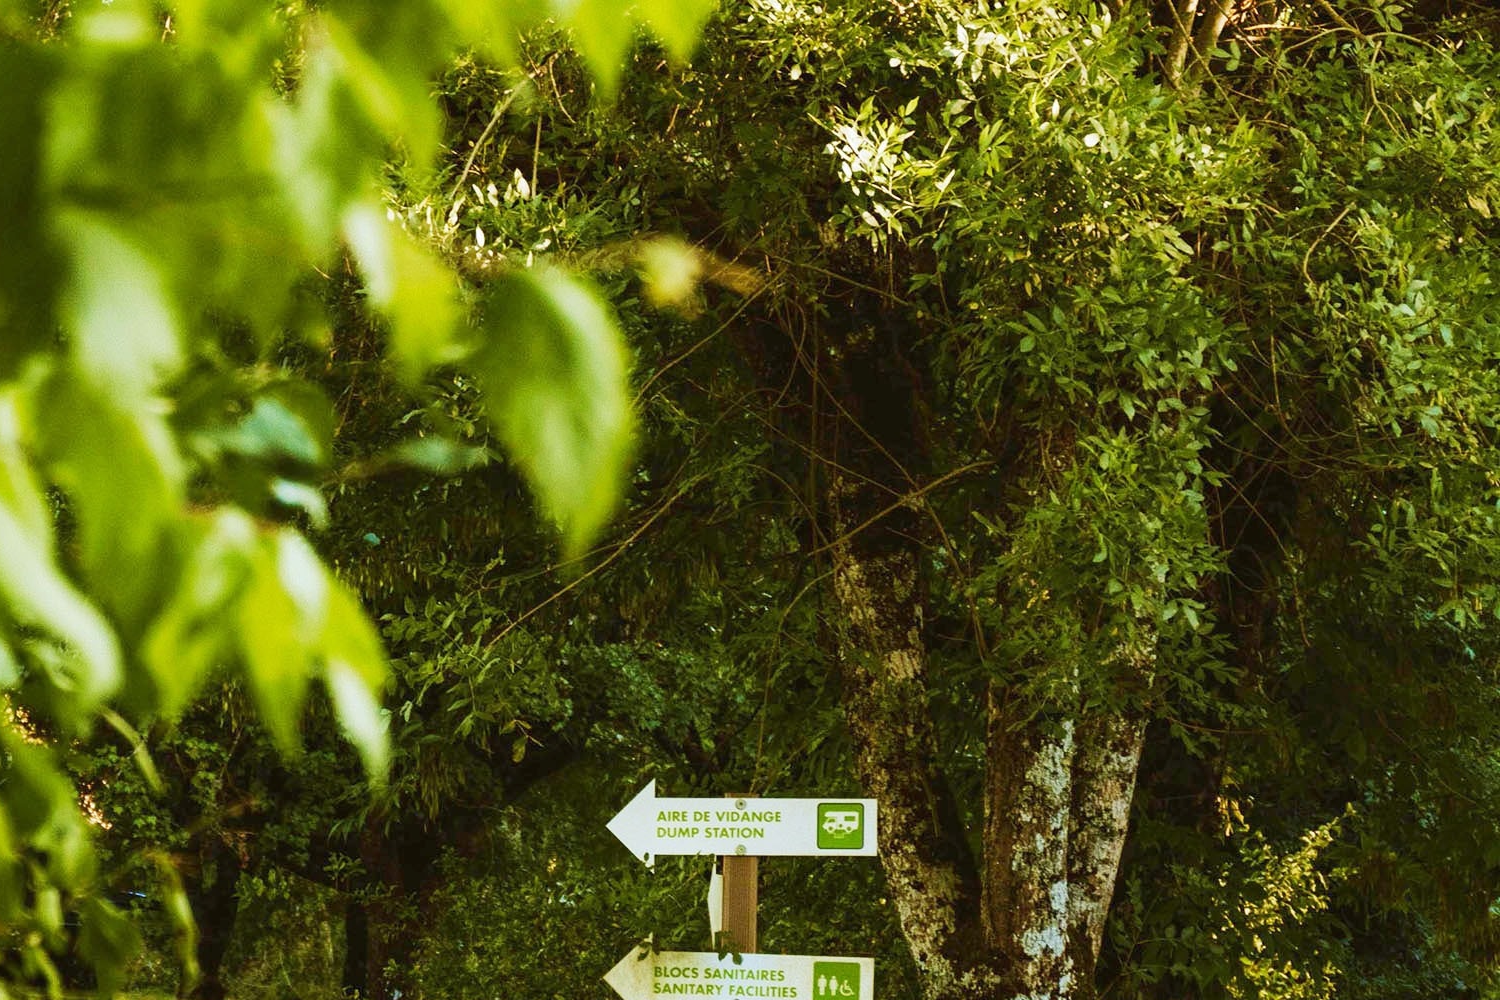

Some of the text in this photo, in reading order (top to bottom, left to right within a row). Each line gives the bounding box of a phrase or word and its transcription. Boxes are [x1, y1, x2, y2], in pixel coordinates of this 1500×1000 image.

[657, 811, 781, 822] AIRE DE VIDANGE
[657, 827, 764, 838] DUMP STATION
[654, 966, 785, 981] BLOCS SANITAIRES
[653, 982, 797, 998] SANITARY FACILITIES
